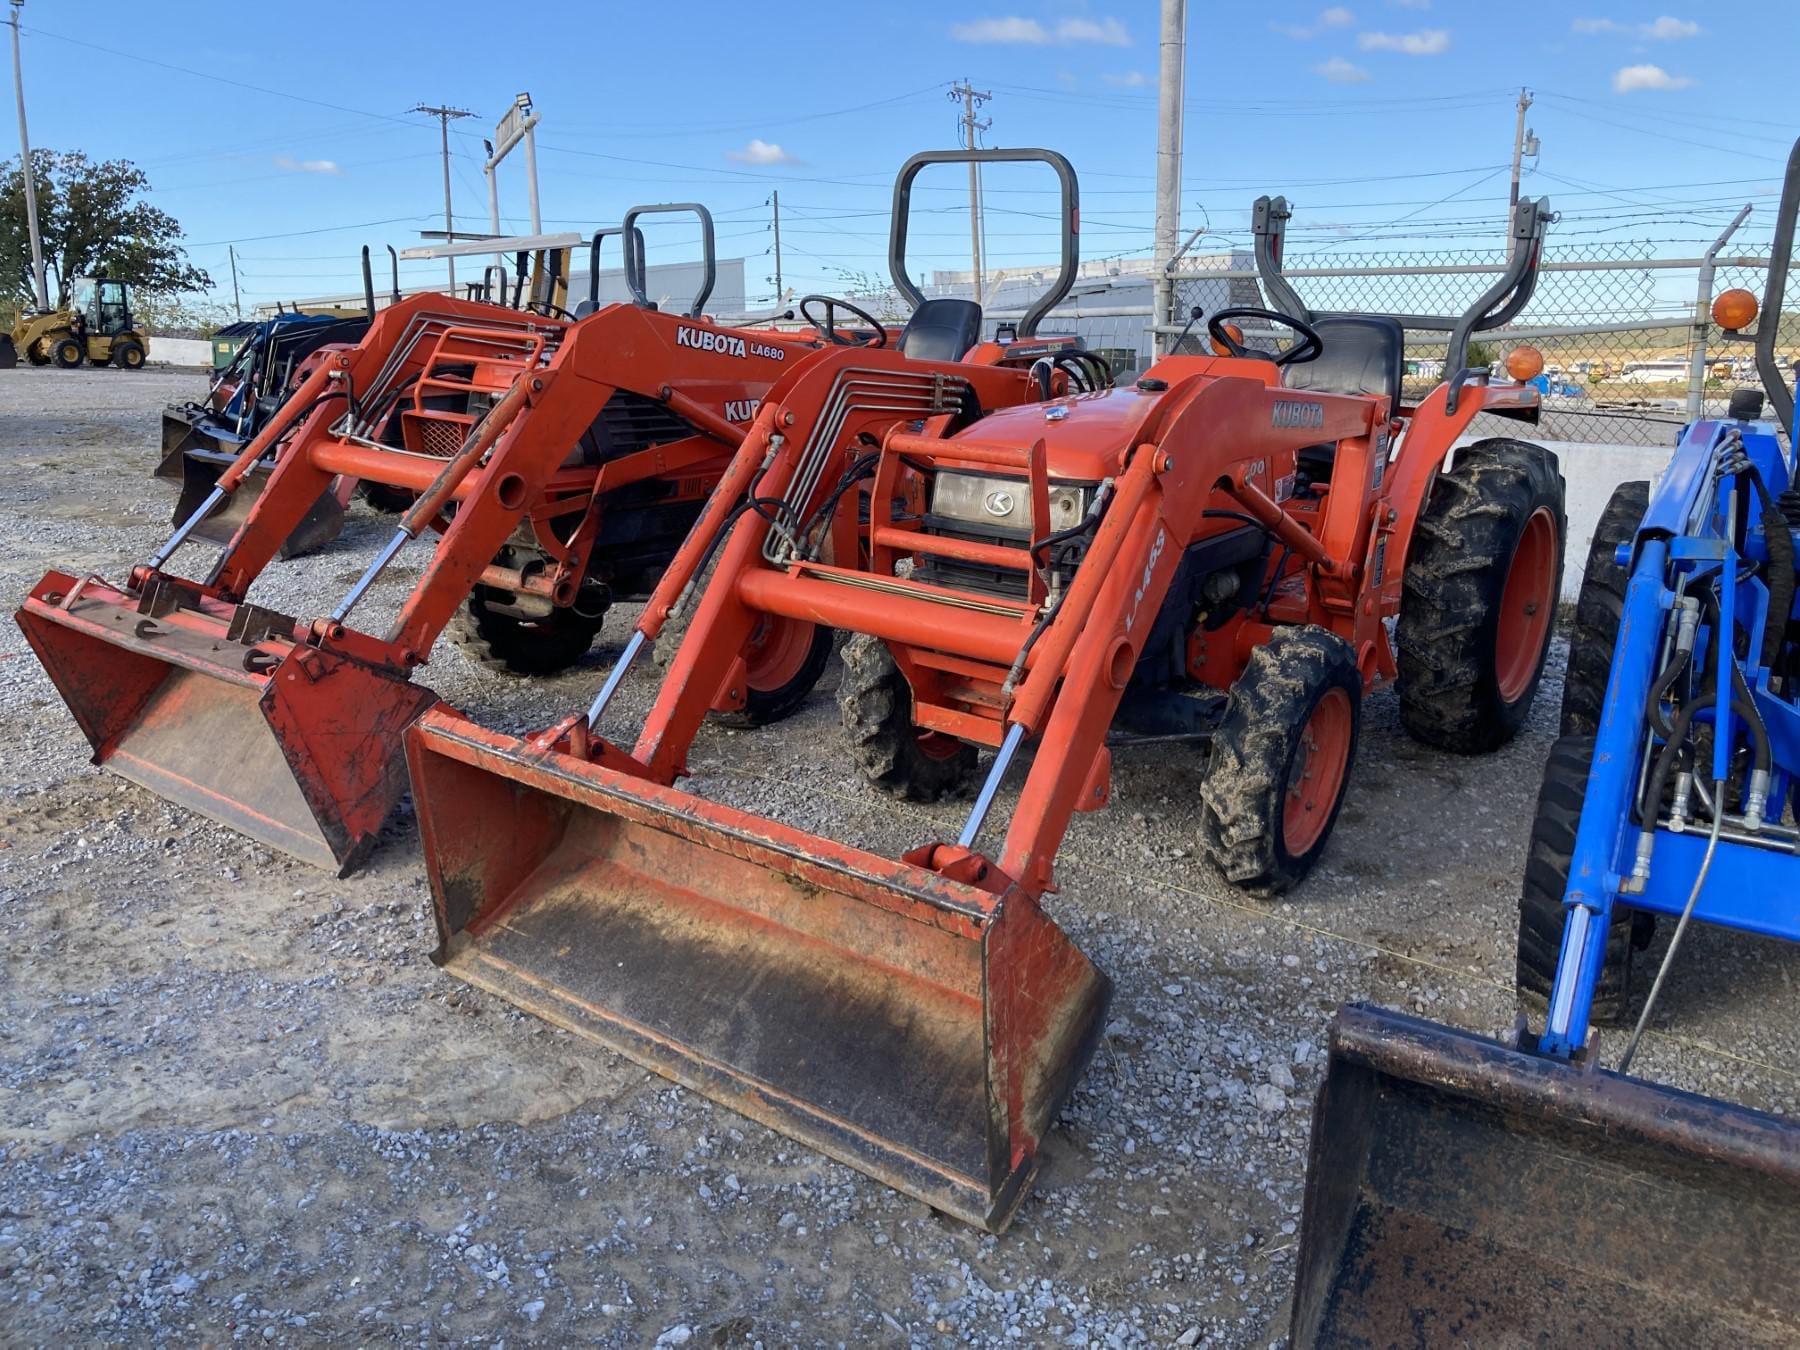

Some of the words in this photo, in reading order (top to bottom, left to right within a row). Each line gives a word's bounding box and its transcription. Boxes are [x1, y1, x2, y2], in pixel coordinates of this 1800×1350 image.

[677, 325, 747, 358] KUBOTA
[750, 342, 785, 361] LA680
[1272, 400, 1323, 428] KUBOTA
